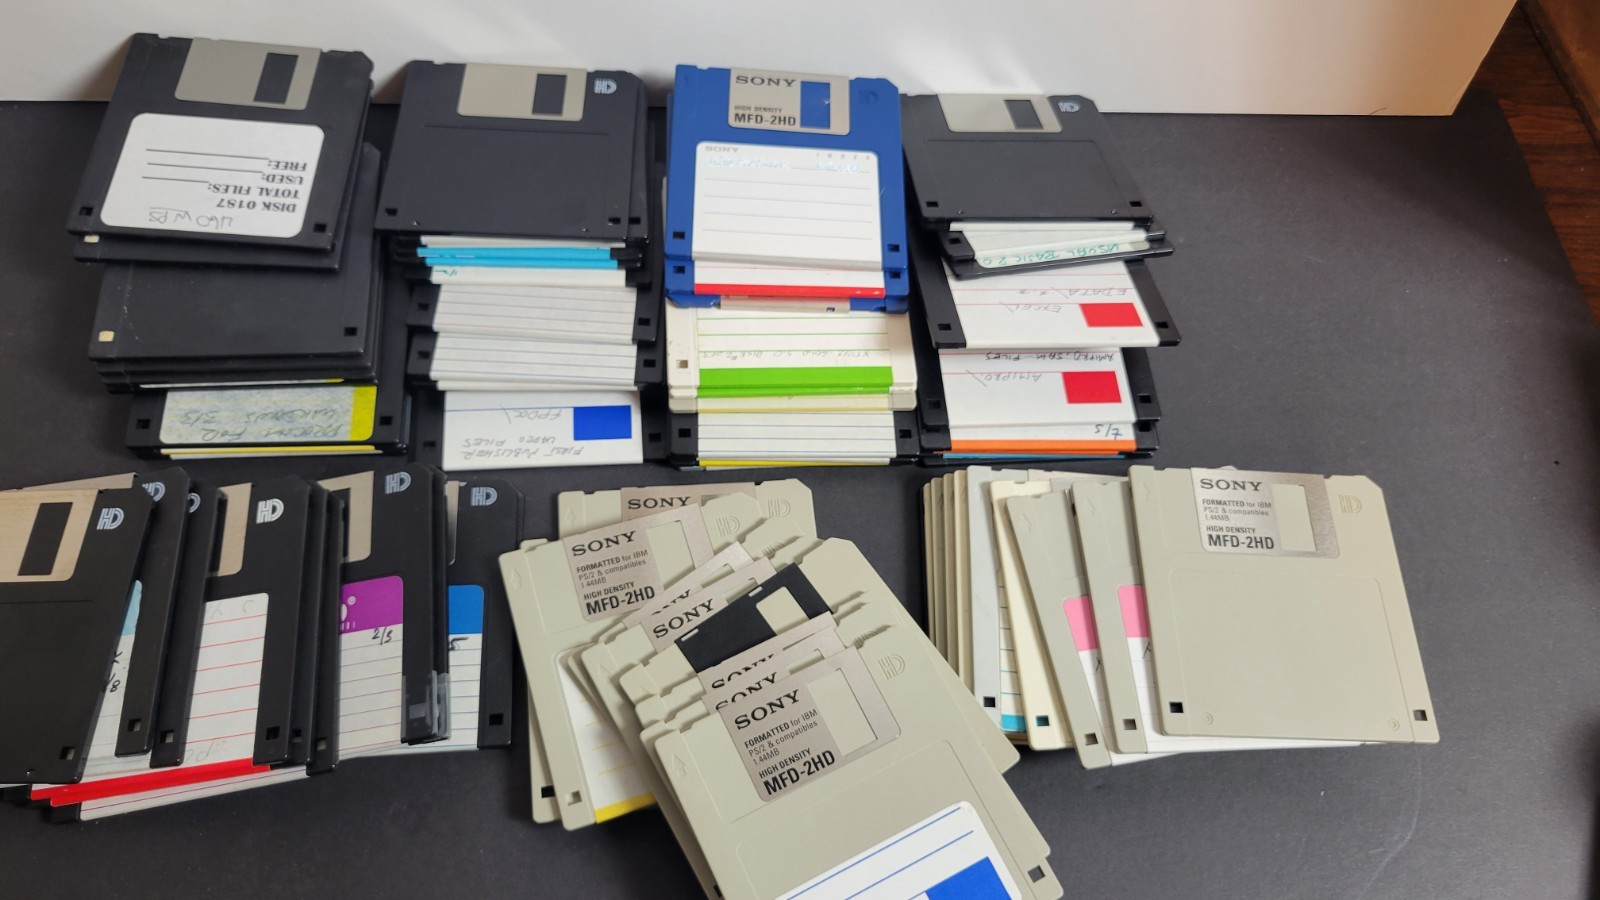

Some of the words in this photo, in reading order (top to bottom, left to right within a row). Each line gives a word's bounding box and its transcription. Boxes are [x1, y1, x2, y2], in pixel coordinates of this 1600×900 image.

[594, 78, 617, 94] HD
[735, 75, 796, 88] SONY
[754, 106, 783, 114] DENSITY
[1058, 101, 1081, 113] HD
[734, 113, 797, 127] MFD-2HD
[268, 160, 307, 172] FREE:
[262, 173, 303, 185] USED:
[208, 183, 251, 196] FILES:
[257, 187, 301, 199] TOTAL
[262, 201, 297, 213] DISK
[1013, 250, 1060, 263] BASIC
[1065, 243, 1119, 257] VISUAL
[985, 351, 1020, 361] FILES
[385, 471, 411, 494] HD
[1200, 479, 1262, 492] SONY
[187, 492, 201, 514] D
[470, 486, 497, 506] HD
[628, 496, 691, 509] SONY
[1202, 499, 1245, 508] FORMATTED
[1257, 501, 1272, 509] IBM
[97, 507, 125, 530] HD
[256, 498, 284, 524] HD
[1228, 508, 1270, 517] compatibles
[1206, 525, 1224, 533] HIGH
[1225, 526, 1256, 534] DENSITY
[572, 530, 636, 557] SONY
[1207, 533, 1275, 550] MFD-2HD
[576, 556, 621, 574] FORMATTED
[621, 554, 633, 562] for
[632, 549, 649, 559] IBM
[578, 572, 595, 581] PS/2
[604, 559, 647, 575] compatibles
[583, 590, 602, 600] HIGH
[603, 581, 635, 596] DENSITY
[586, 585, 656, 616] MFD-2HD
[653, 598, 714, 639] SONY
[734, 688, 799, 730] SONY
[744, 722, 790, 749] FORMATTED
[789, 716, 802, 730] for
[801, 709, 818, 724] IBM
[748, 744, 767, 758] PS/2
[767, 739, 776, 749] &
[775, 719, 819, 746] compatibles
[752, 747, 781, 766] 1.44MB
[758, 762, 778, 779] HIGH
[776, 747, 812, 770] DENSITY
[763, 750, 836, 796] MFD-2HD
